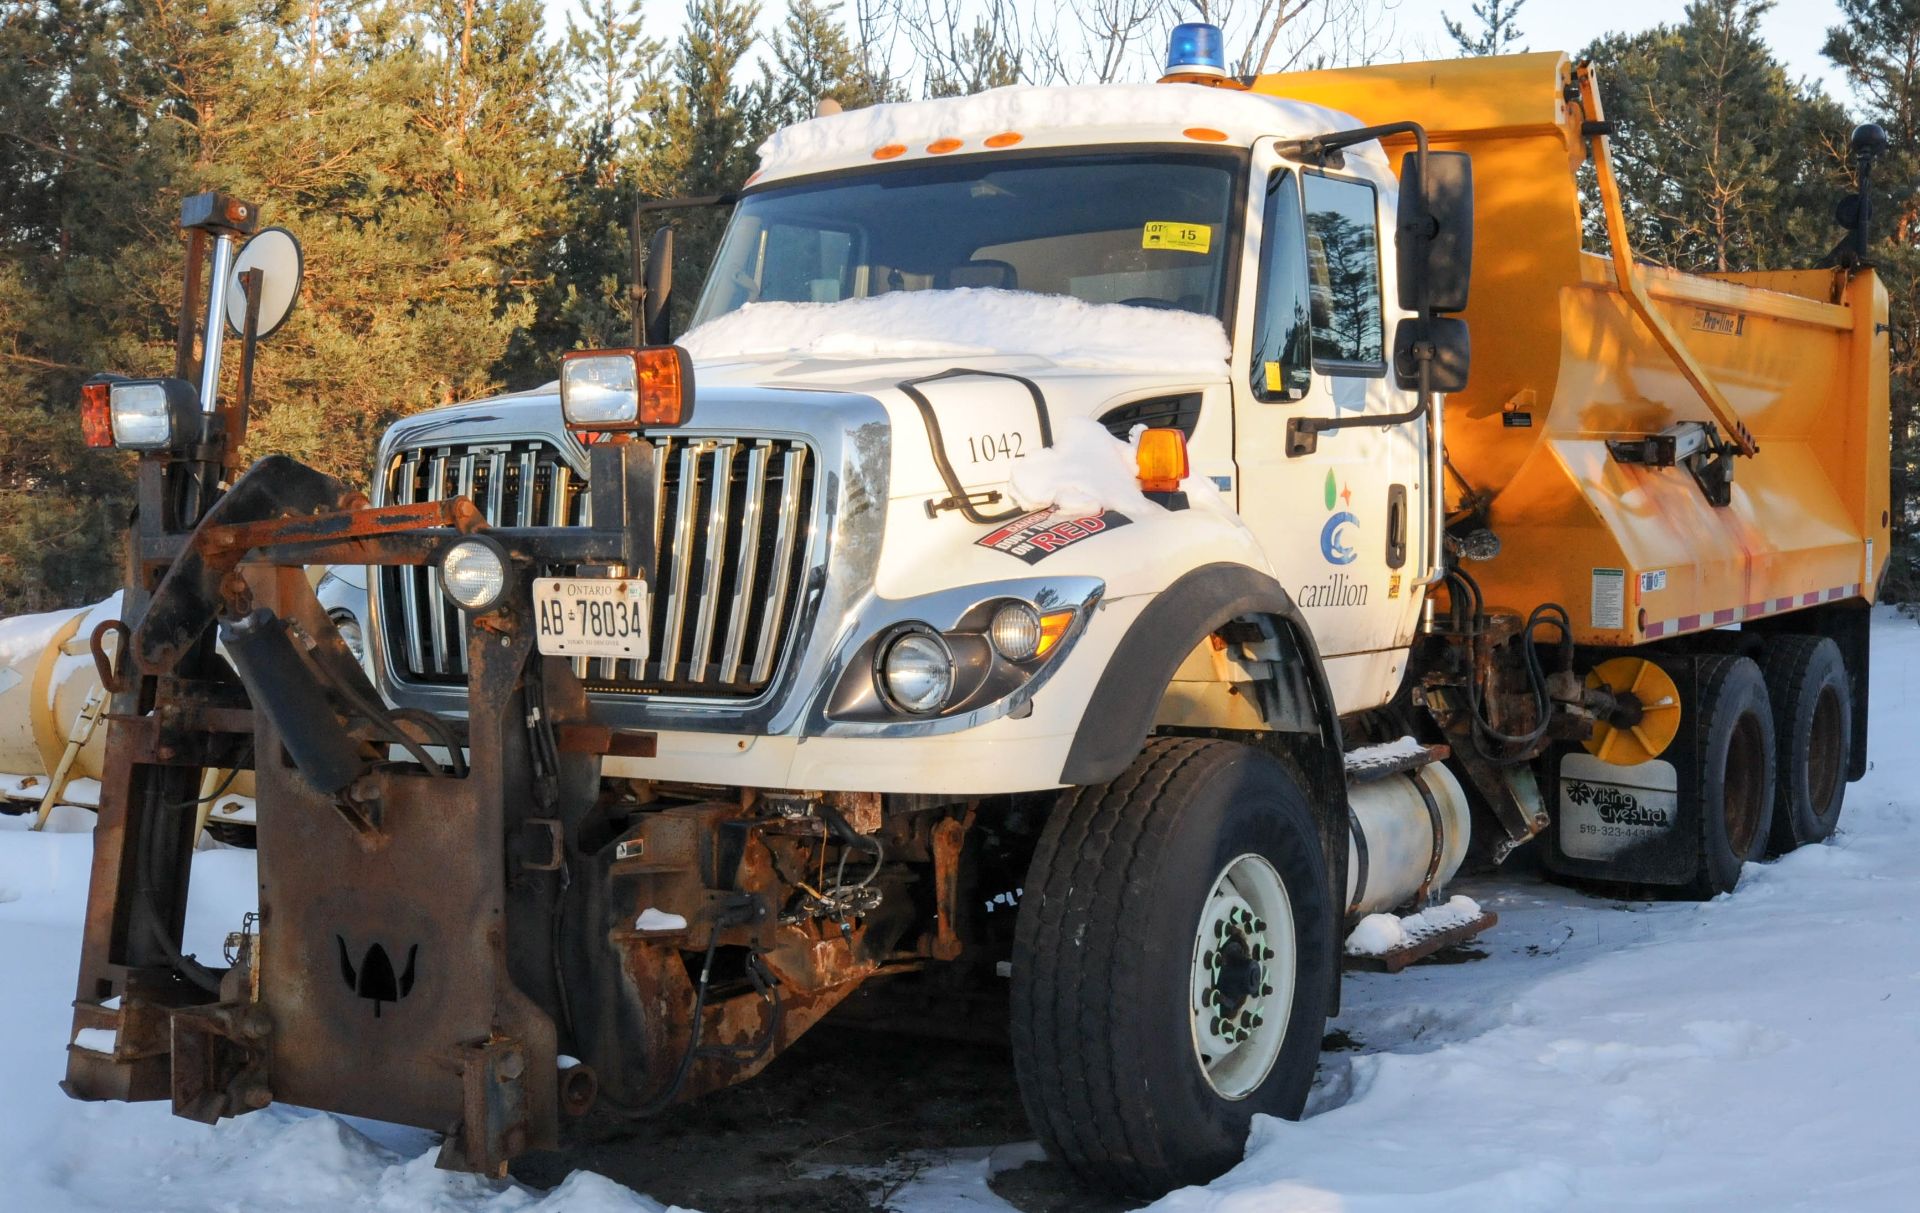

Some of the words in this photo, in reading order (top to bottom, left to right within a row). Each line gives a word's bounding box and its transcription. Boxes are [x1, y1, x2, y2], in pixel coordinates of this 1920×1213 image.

[1180, 229, 1197, 241] 15
[968, 431, 1025, 463] 1042
[1010, 542, 1036, 556] ON
[1027, 516, 1106, 553] RED
[567, 583, 612, 596] ONTARIO
[1298, 573, 1368, 608] carillion
[541, 599, 564, 636] AB
[576, 600, 641, 638] 78034
[1587, 786, 1635, 810] Viking
[1598, 803, 1638, 822] Cives
